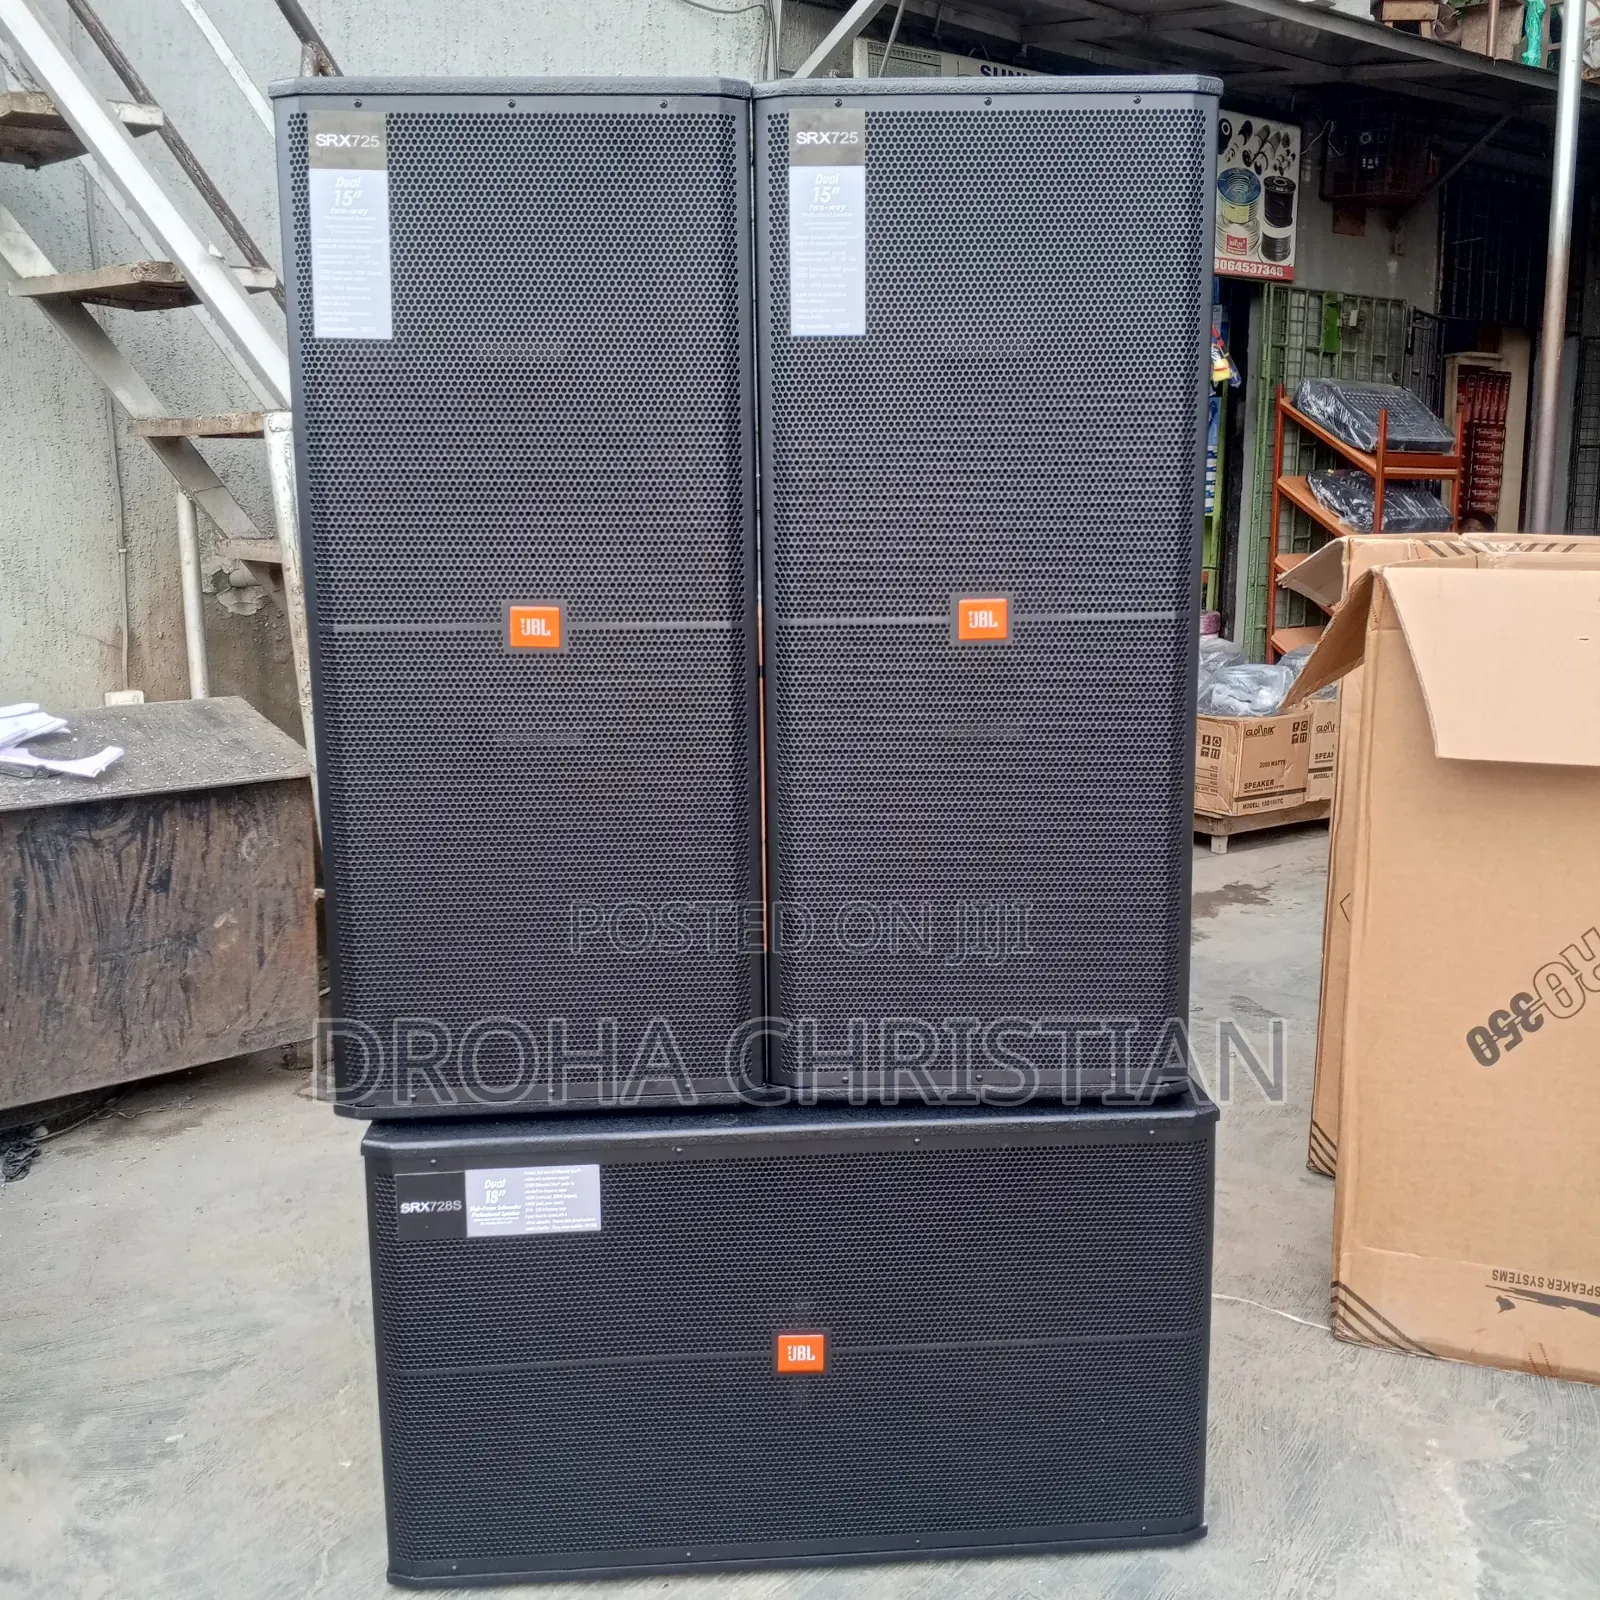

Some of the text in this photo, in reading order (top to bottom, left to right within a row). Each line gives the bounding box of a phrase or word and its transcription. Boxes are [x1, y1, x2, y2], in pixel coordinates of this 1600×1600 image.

[315, 133, 380, 148] SRX725
[796, 131, 859, 145] SRX725
[336, 176, 361, 188] Dual
[815, 173, 840, 185] Dual
[330, 206, 368, 216] two-way
[809, 204, 846, 213] two-way
[967, 610, 998, 629] JBL
[520, 617, 551, 636] JBL
[1271, 759, 1286, 767] WATTS
[1244, 778, 1275, 789] SPEAKER
[484, 1178, 506, 1189] Dual
[400, 1200, 462, 1214] SRX728S
[1492, 1269, 1600, 1298] SPEAKER SYSTEMS
[787, 1344, 816, 1362] JBL
